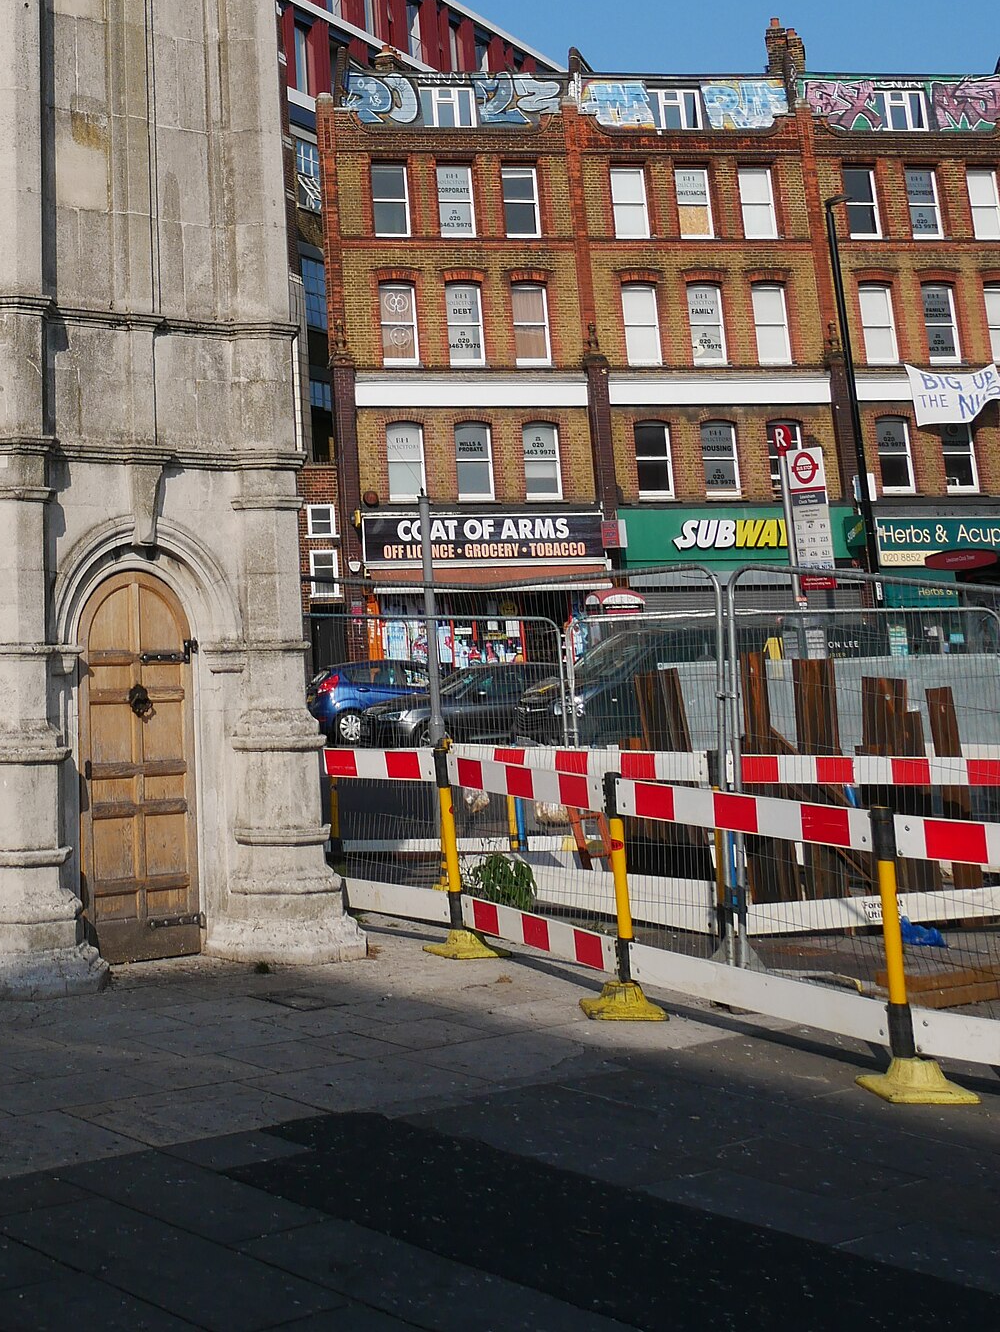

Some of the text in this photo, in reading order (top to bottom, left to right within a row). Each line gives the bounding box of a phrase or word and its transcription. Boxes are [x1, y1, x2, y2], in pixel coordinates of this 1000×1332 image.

[920, 371, 993, 391] BIG UP
[918, 394, 949, 408] THE
[775, 428, 787, 447] R
[463, 519, 495, 541] OF
[501, 518, 570, 540] ARMS
[881, 524, 931, 543] Herbs
[935, 524, 949, 543] &
[383, 542, 586, 559] OFF LICNCE GROCERY TOBACCO
[883, 552, 921, 563] 020 8852
[918, 587, 944, 596] Herbs
[844, 640, 859, 648] LEE
